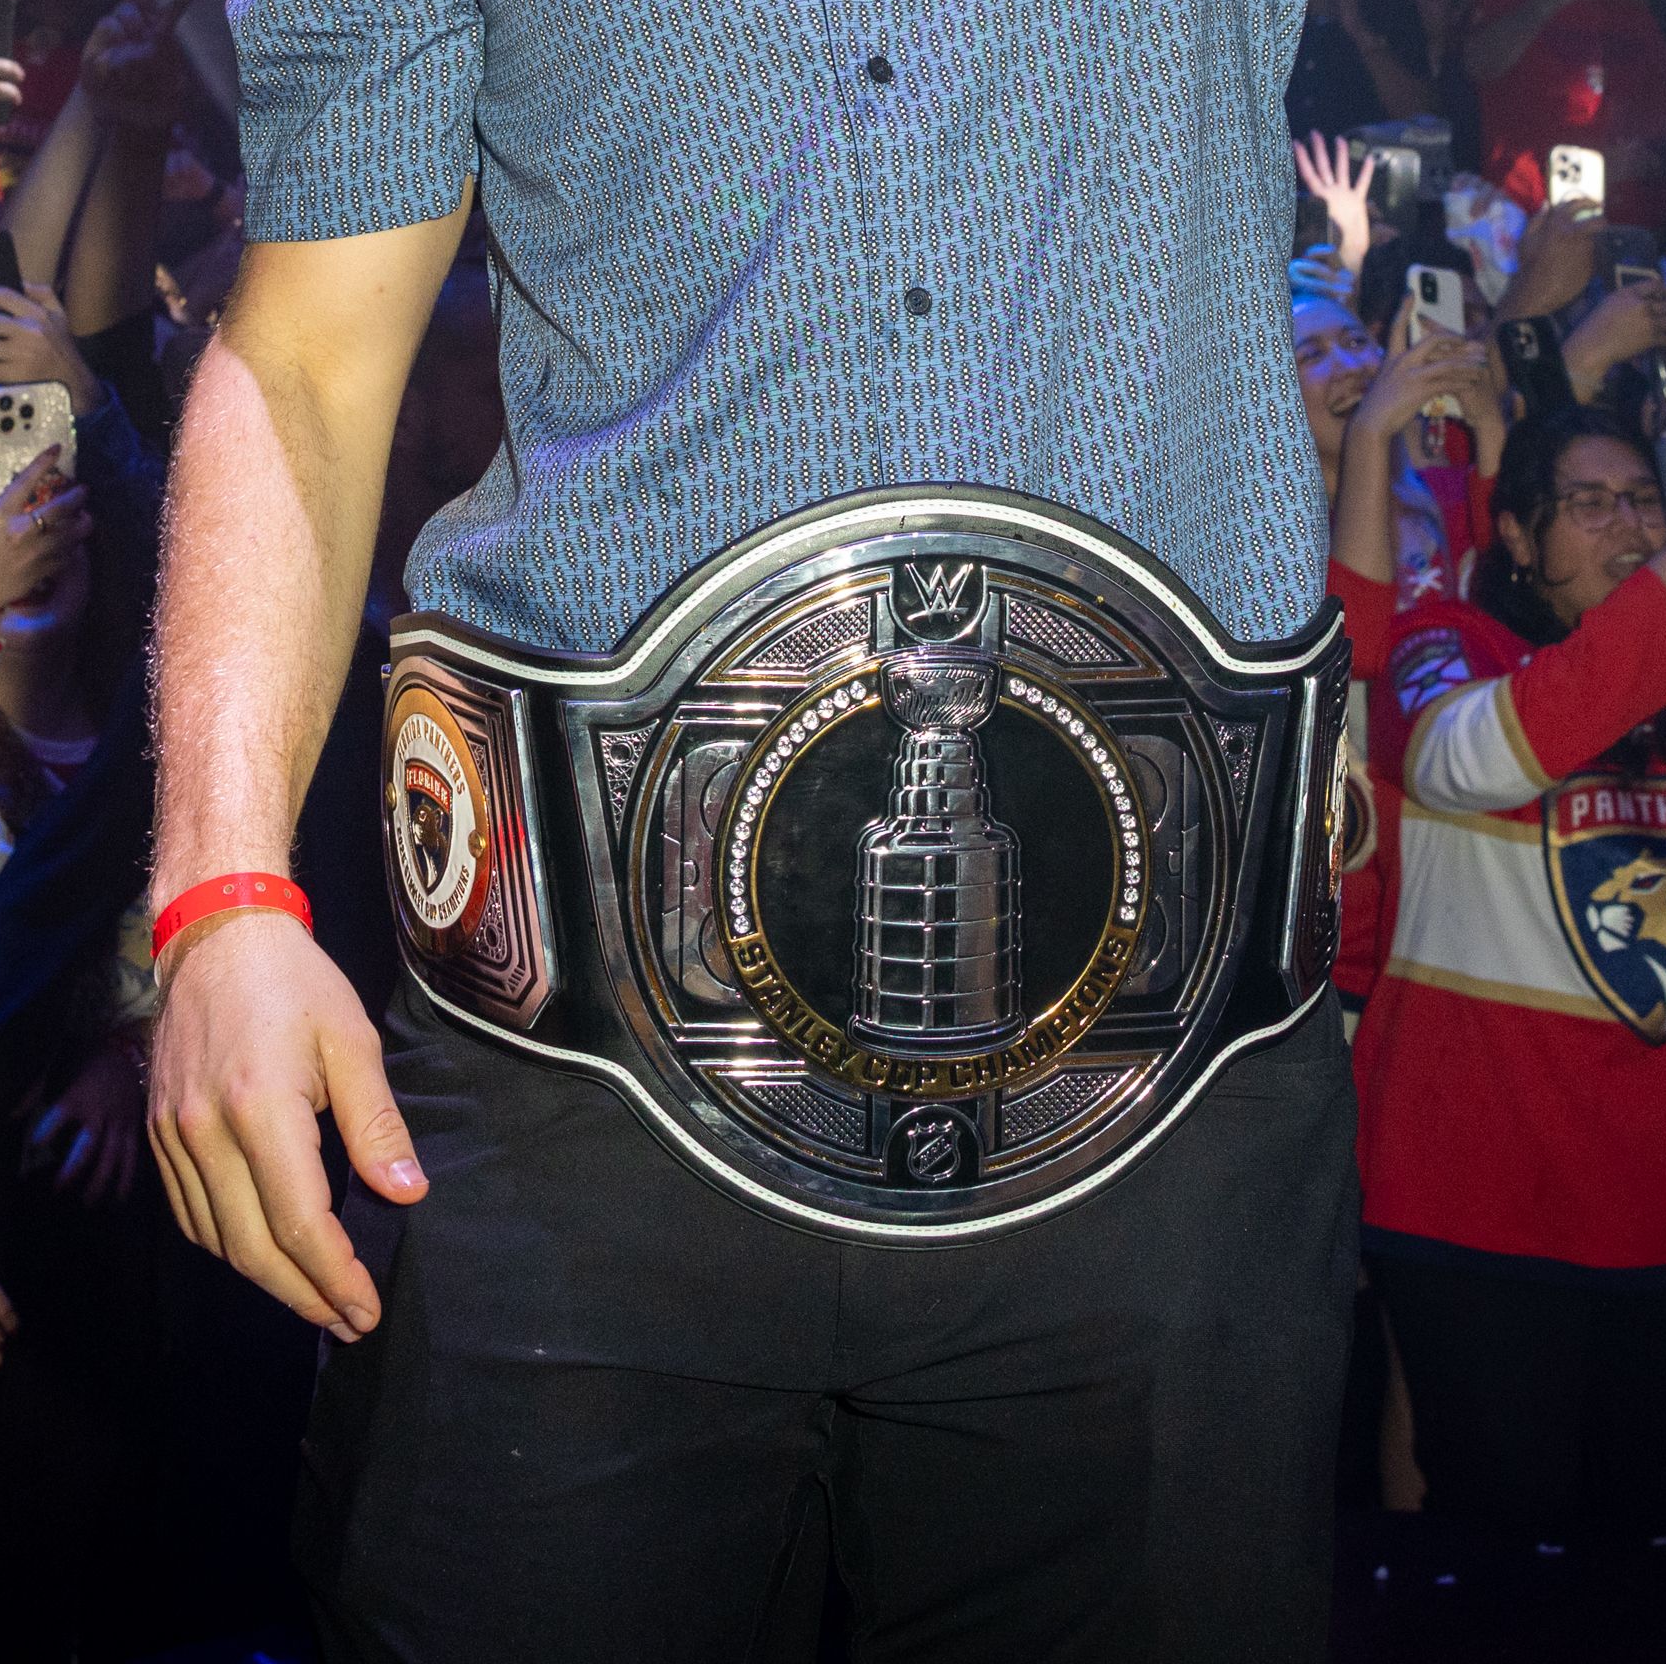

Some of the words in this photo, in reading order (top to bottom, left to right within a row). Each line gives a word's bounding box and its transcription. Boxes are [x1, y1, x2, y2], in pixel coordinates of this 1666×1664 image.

[423, 720, 466, 796] PANTHERS
[438, 863, 470, 921] CHAMPIONS
[733, 940, 859, 1072] STANLEY
[863, 1054, 938, 1091] CUP
[948, 933, 1133, 1089] CHAMPIONS
